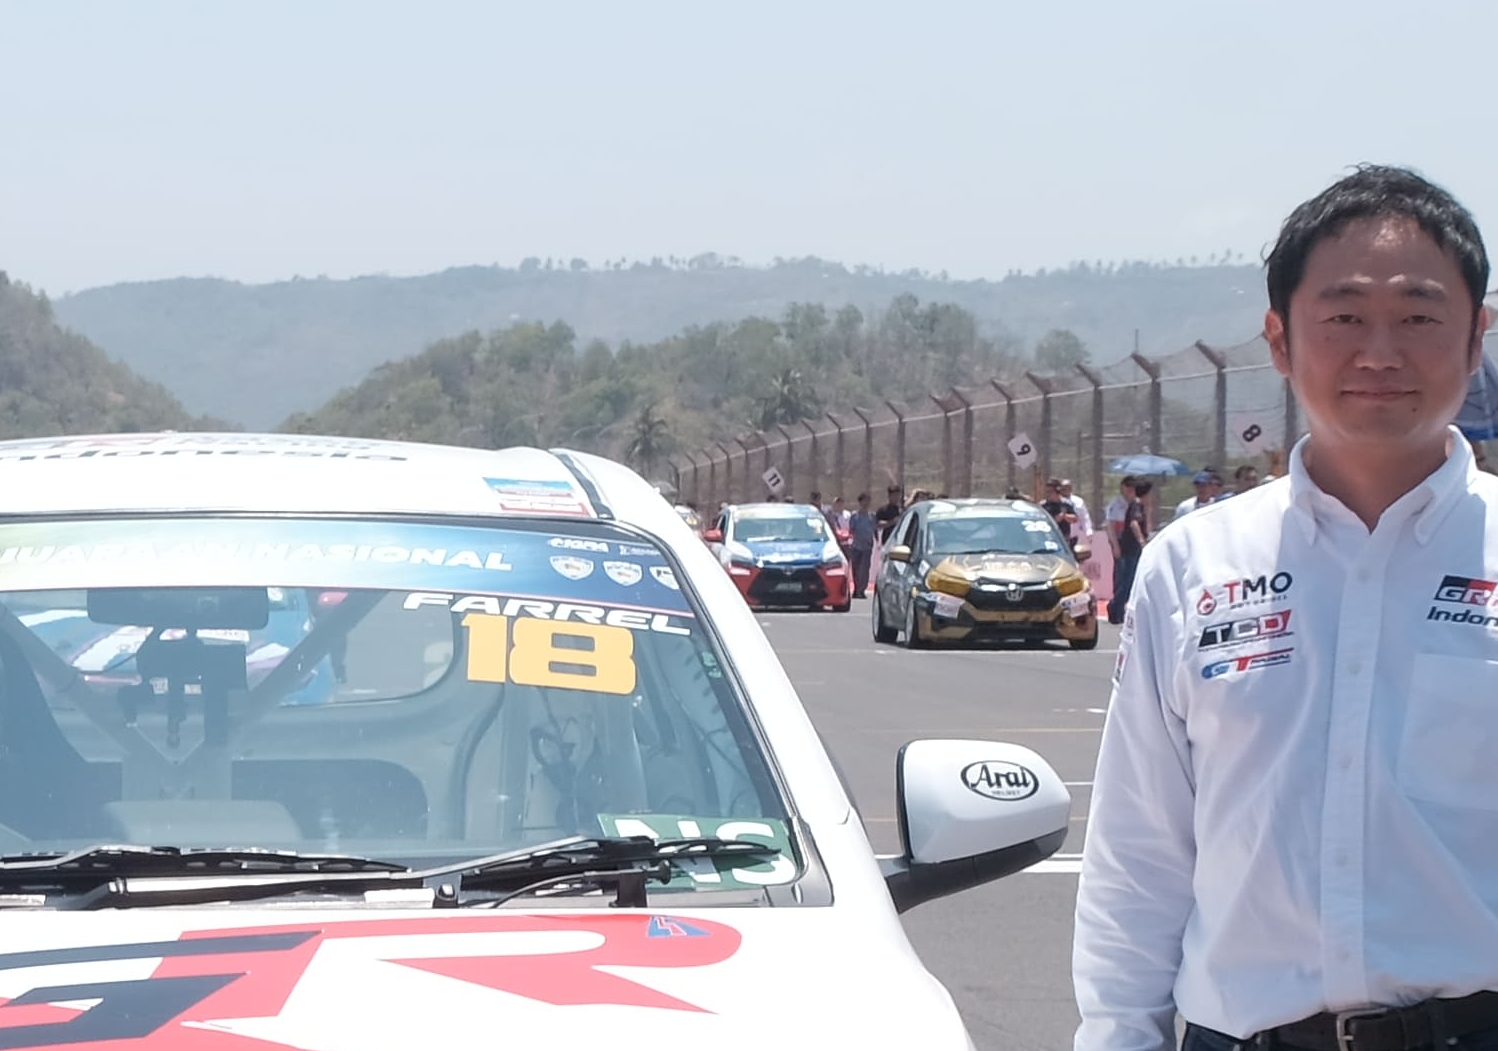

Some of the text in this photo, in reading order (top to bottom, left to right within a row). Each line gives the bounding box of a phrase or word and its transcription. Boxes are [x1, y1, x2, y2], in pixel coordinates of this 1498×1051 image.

[252, 542, 512, 571] NASIONAL
[1223, 572, 1293, 604] TMO
[1435, 579, 1497, 606] GR
[404, 592, 692, 636] FARREL
[1202, 613, 1288, 645] TCD
[461, 613, 636, 695] 18
[970, 764, 1031, 788] Arai
